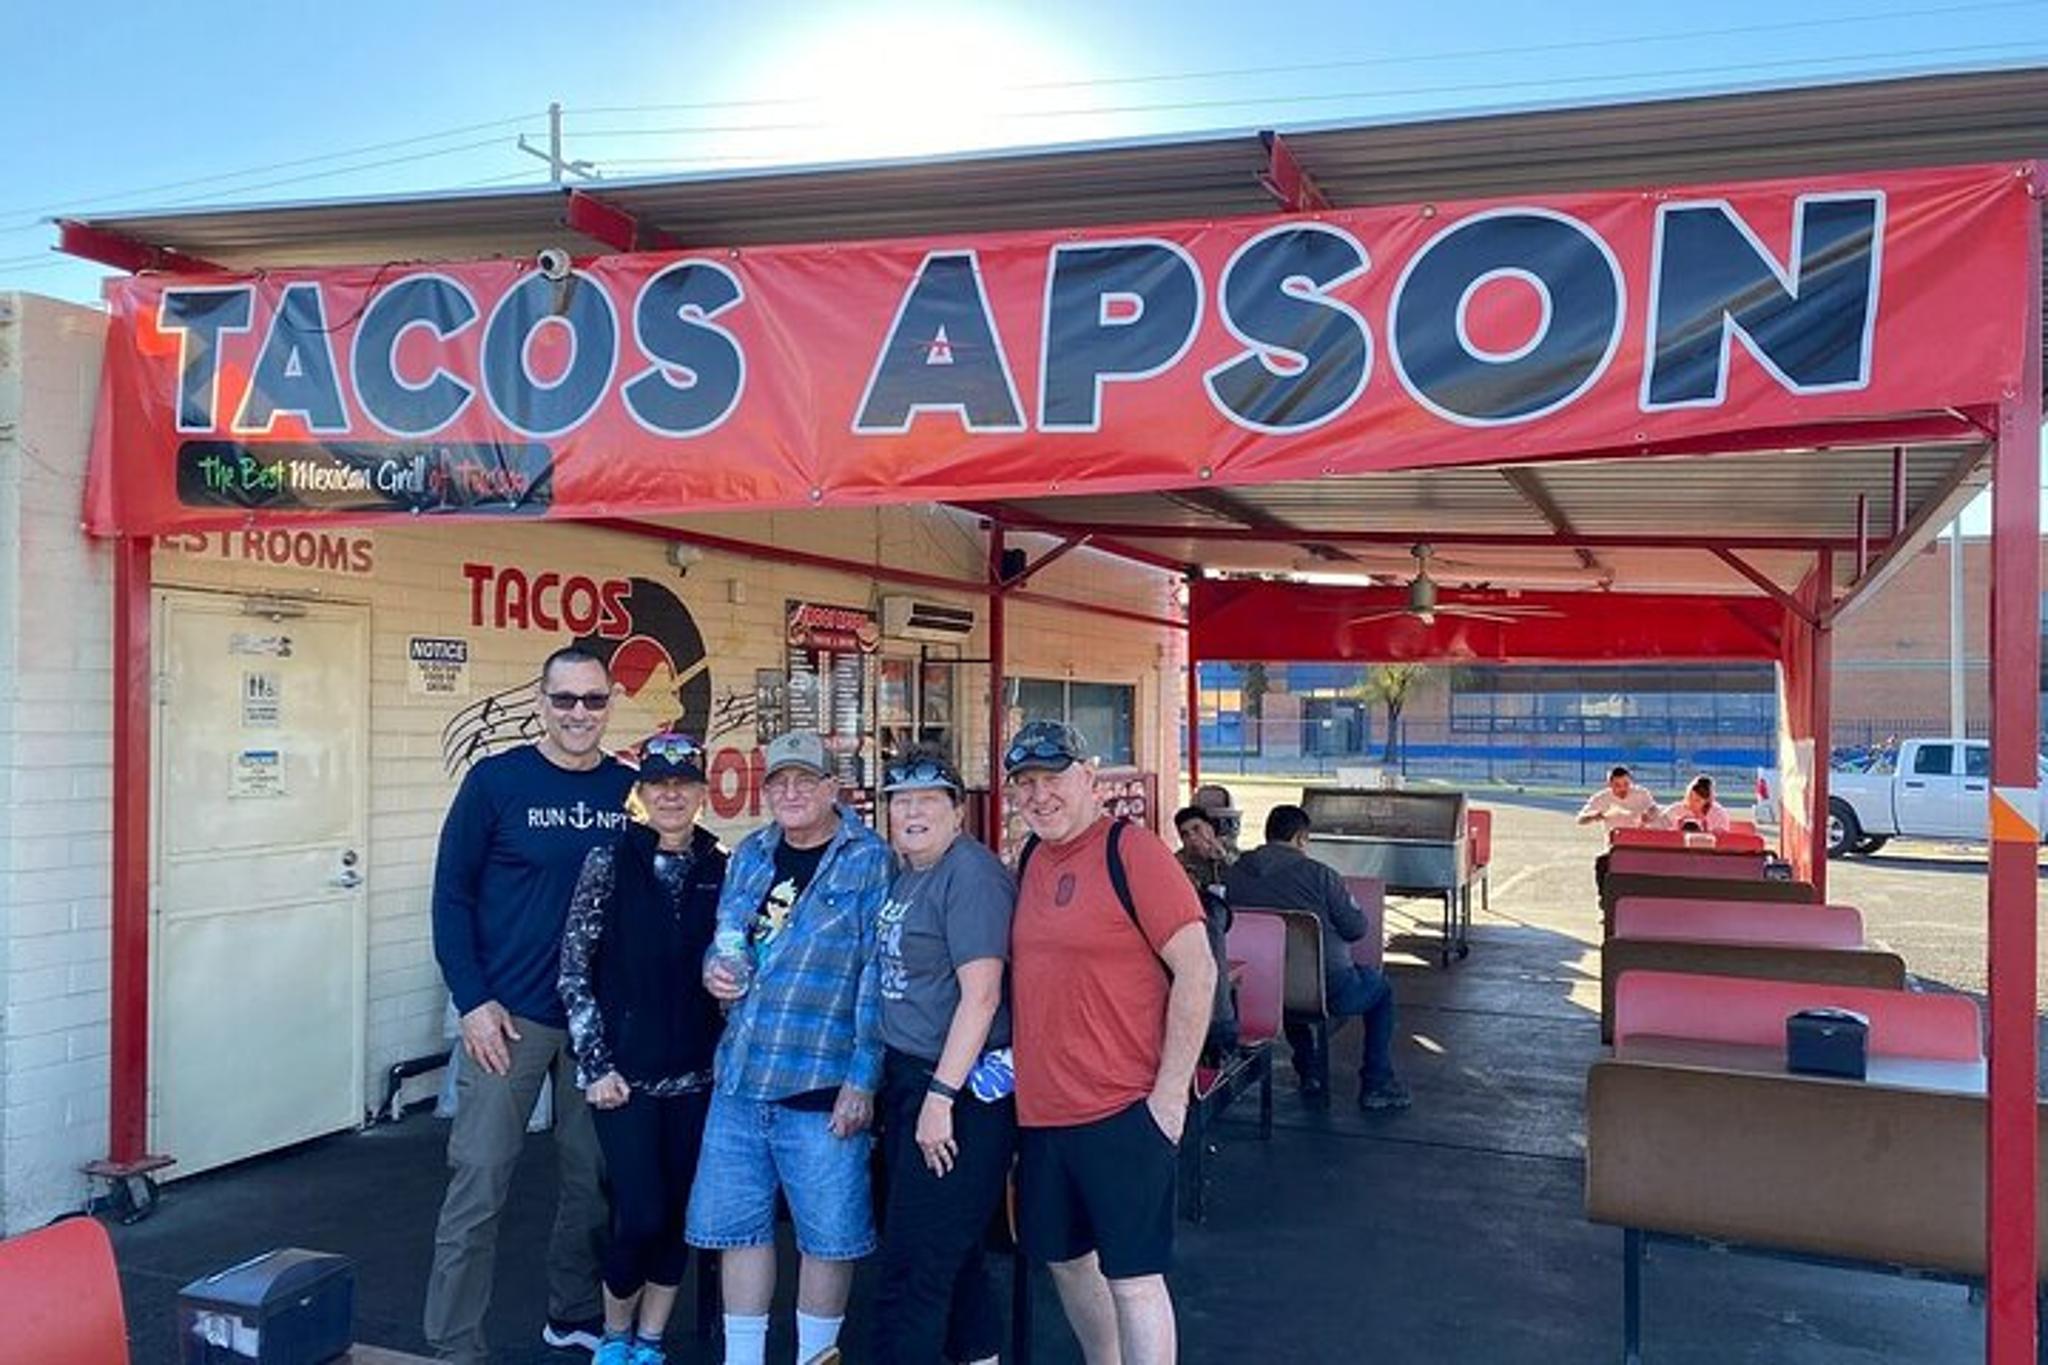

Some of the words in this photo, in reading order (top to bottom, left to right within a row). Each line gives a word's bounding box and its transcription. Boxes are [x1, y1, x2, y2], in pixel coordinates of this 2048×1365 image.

[157, 258, 747, 438] TACOS
[851, 191, 1887, 435] APSON
[239, 456, 286, 492] Best
[289, 459, 371, 491] Mexican
[377, 454, 425, 494] Grill
[158, 529, 374, 573] ESTROOMS
[463, 562, 632, 638] TACOS
[411, 641, 465, 660] NOTICE
[527, 807, 566, 828] RUN
